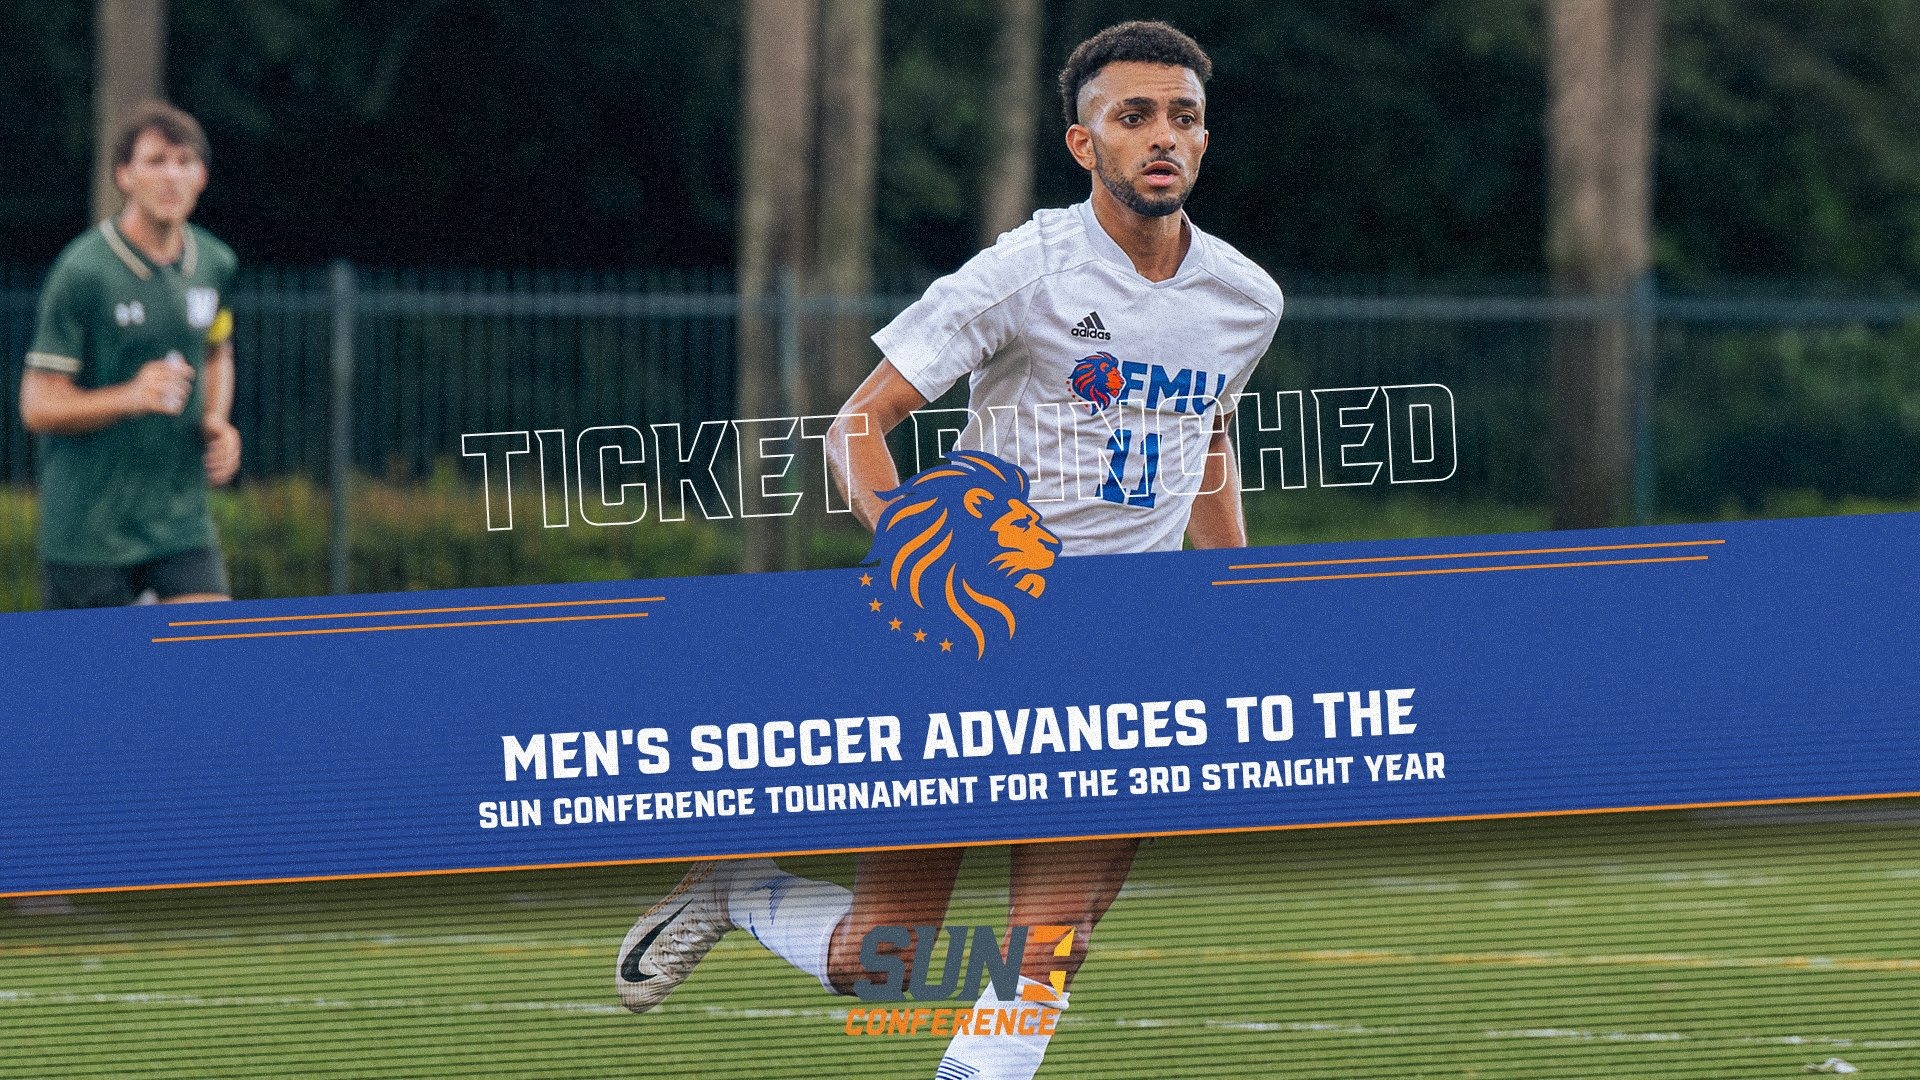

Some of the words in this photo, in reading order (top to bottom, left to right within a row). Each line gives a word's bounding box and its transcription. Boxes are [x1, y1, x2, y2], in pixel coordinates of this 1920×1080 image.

[1071, 326, 1111, 341] adidas
[1116, 360, 1226, 415] FMU
[1095, 428, 1162, 509] 11
